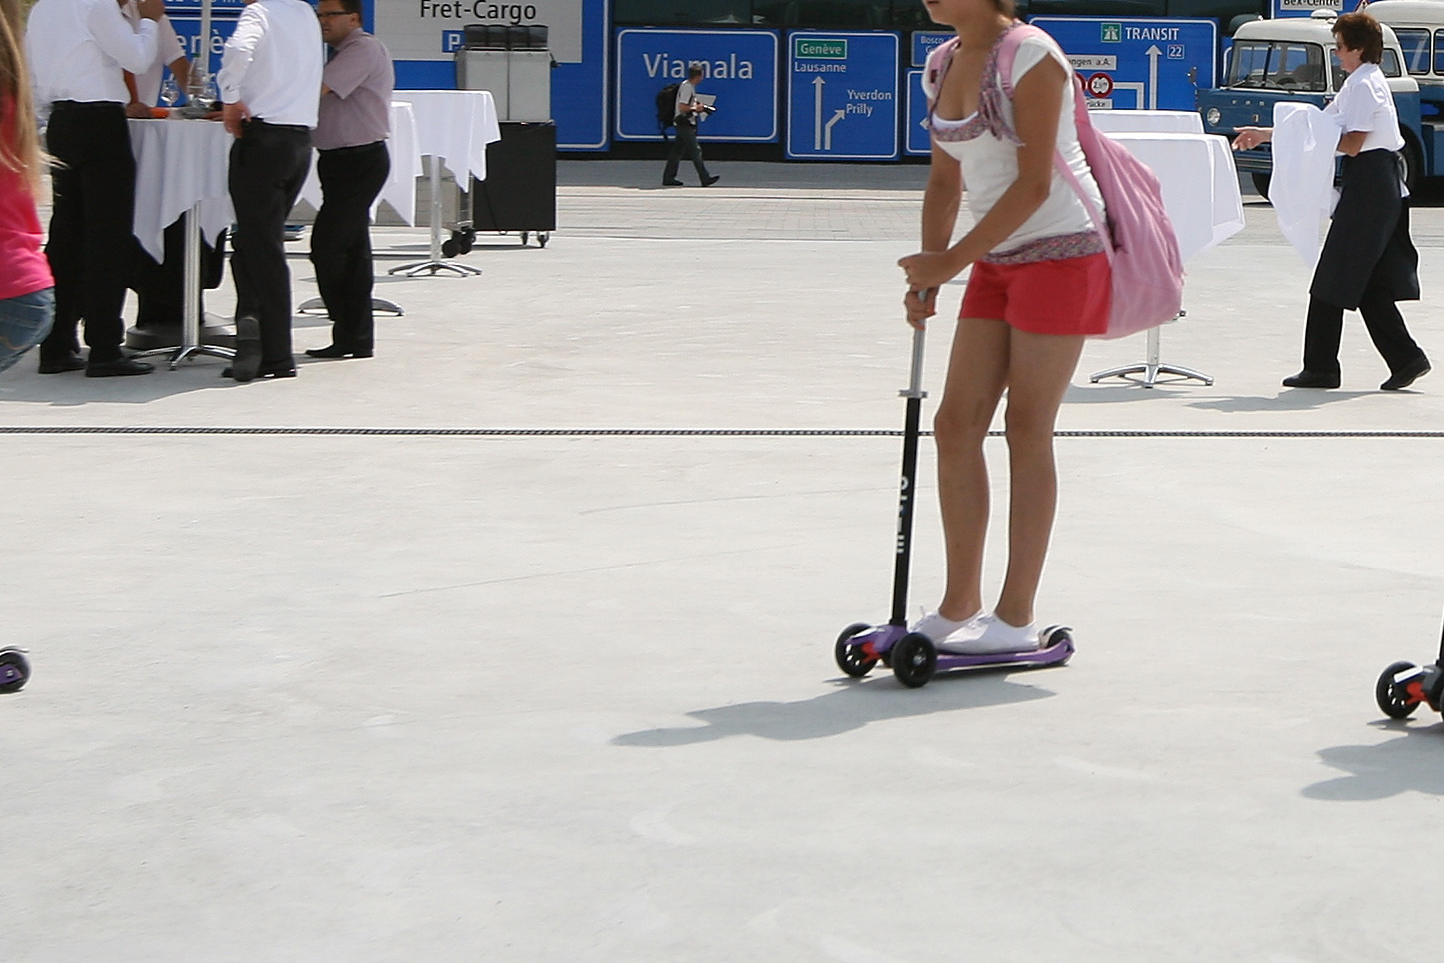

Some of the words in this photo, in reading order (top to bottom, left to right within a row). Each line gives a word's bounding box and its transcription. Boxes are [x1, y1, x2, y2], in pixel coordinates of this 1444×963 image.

[420, 0, 536, 25] Fret-Cargo
[1125, 27, 1179, 40] TRANSIT
[643, 53, 752, 78] Viamala
[847, 89, 891, 100] Yverdon
[847, 103, 872, 117] Prilly
